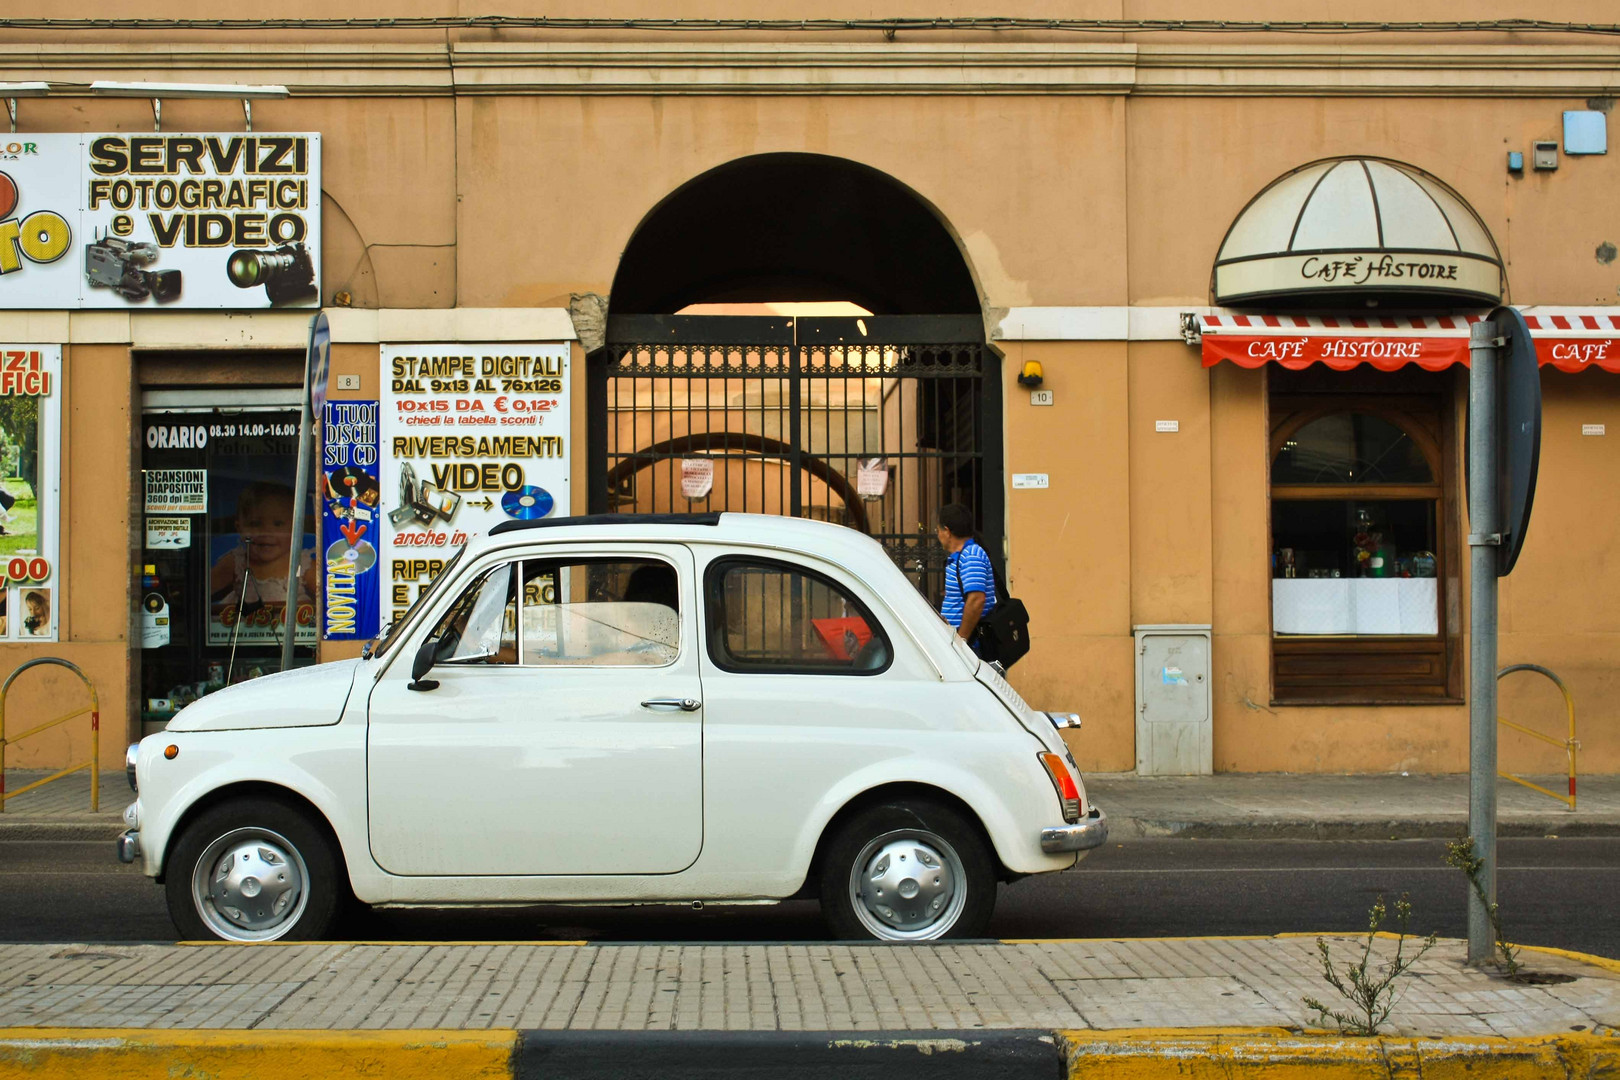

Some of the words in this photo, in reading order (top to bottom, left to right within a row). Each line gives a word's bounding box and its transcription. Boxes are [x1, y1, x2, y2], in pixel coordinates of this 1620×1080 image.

[89, 136, 309, 175] SERVIZI
[89, 178, 309, 211] FOTOGRAFICI
[110, 214, 133, 236] e
[147, 211, 308, 248] VIDEO
[1354, 255, 1458, 284] HISTOIRE
[1320, 339, 1422, 358] HISTOIRE
[0, 350, 41, 373] ZI
[392, 356, 476, 378] STAMPE
[481, 356, 562, 378] DIGITALI
[345, 378, 352, 387] 8
[391, 379, 426, 394] DAL
[430, 379, 469, 394] 9x13
[473, 379, 496, 394] AL
[500, 379, 562, 394] 76x126
[396, 399, 449, 412] 10x15
[455, 399, 485, 412] DA
[493, 396, 508, 413] €
[1037, 393, 1047, 402] 10
[325, 404, 333, 424] I
[336, 404, 376, 424] TUOI
[406, 415, 441, 426] chiedi
[443, 415, 454, 425] la
[458, 415, 496, 425] tabella
[500, 415, 537, 425] sconti
[147, 425, 208, 449] ORARIO
[209, 425, 235, 437] 08.30
[325, 424, 376, 444] DISCHI
[325, 445, 348, 466] SU
[353, 445, 377, 466] CD
[392, 436, 562, 457] RIVERSAMENTI
[147, 471, 203, 483] SCANSIONI
[431, 463, 525, 492] VIDEO
[147, 483, 204, 494] DIAPOSITIVE
[147, 495, 168, 503] 3600
[169, 495, 182, 504] dpi
[393, 529, 447, 546] anche
[450, 529, 467, 545] in
